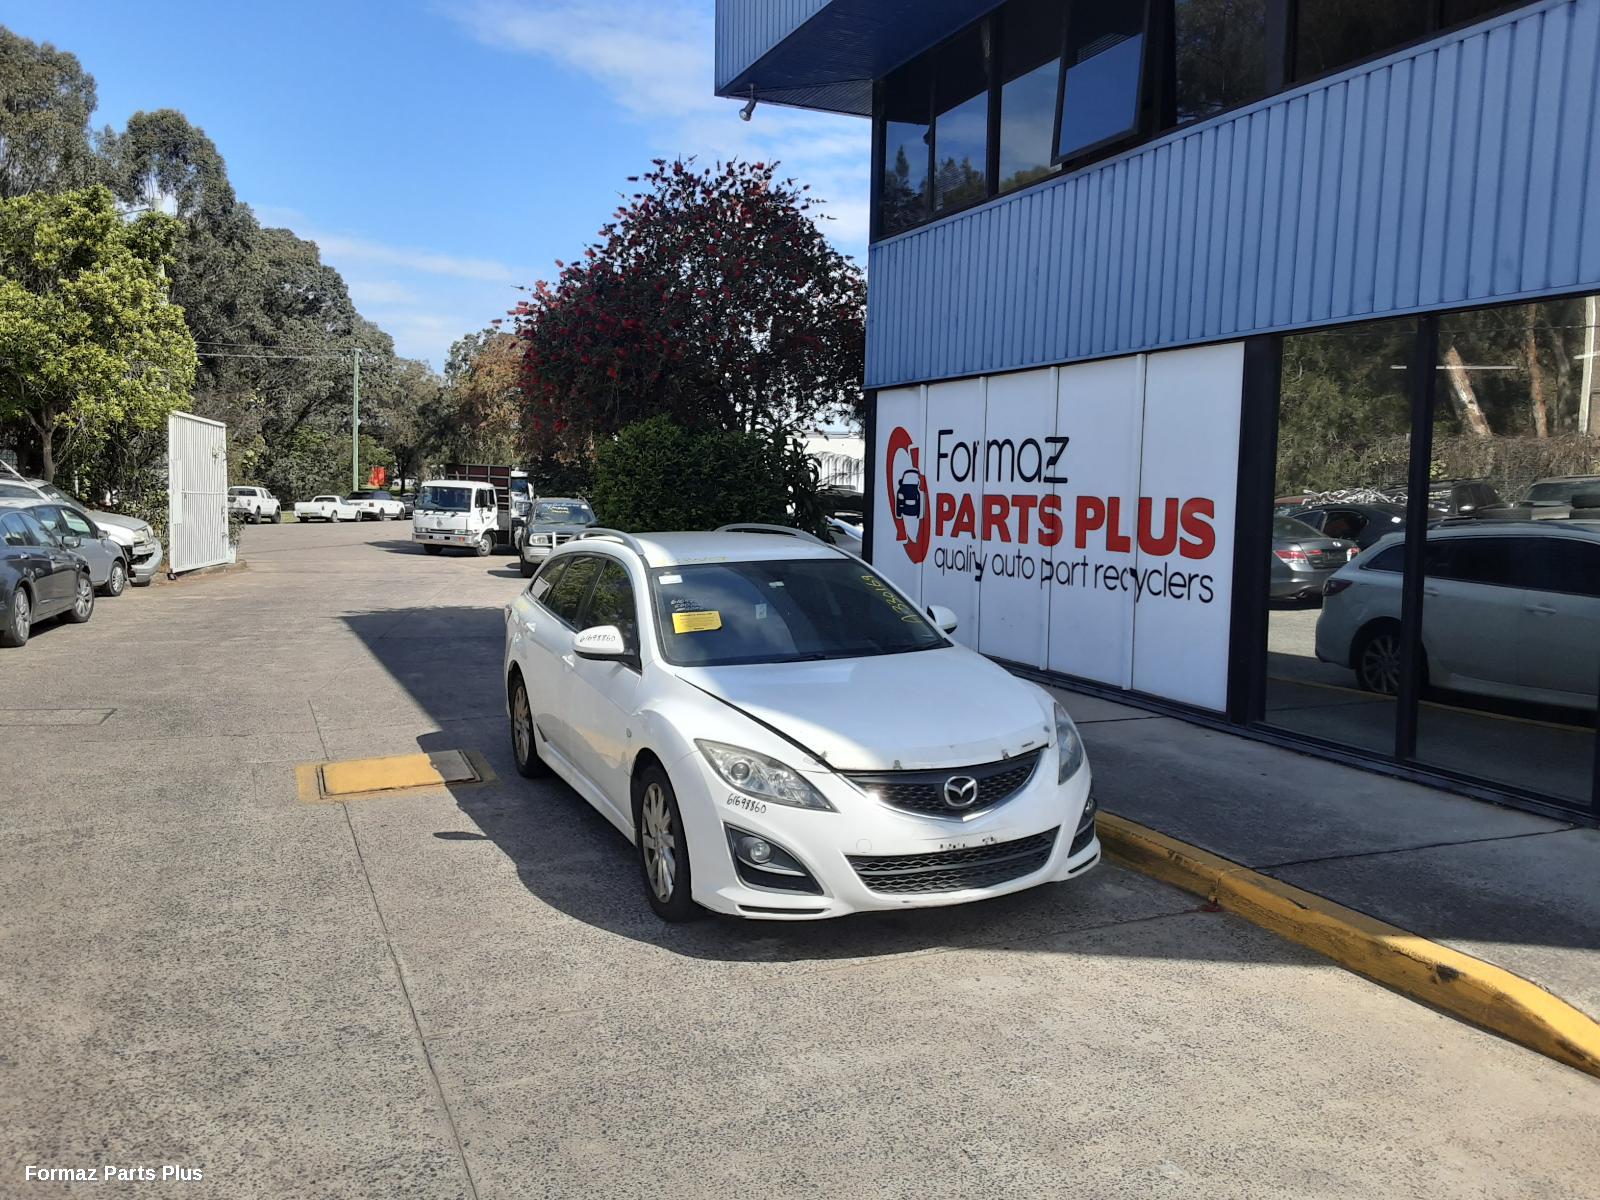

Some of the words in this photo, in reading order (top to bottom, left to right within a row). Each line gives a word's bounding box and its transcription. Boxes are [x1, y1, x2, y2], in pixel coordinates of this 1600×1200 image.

[936, 429, 1070, 484] Formaz
[935, 492, 1064, 547] PARTS
[1074, 495, 1217, 560] PLUS
[992, 548, 1036, 580] auto
[1040, 555, 1089, 591] part
[1094, 562, 1214, 604] recyclers
